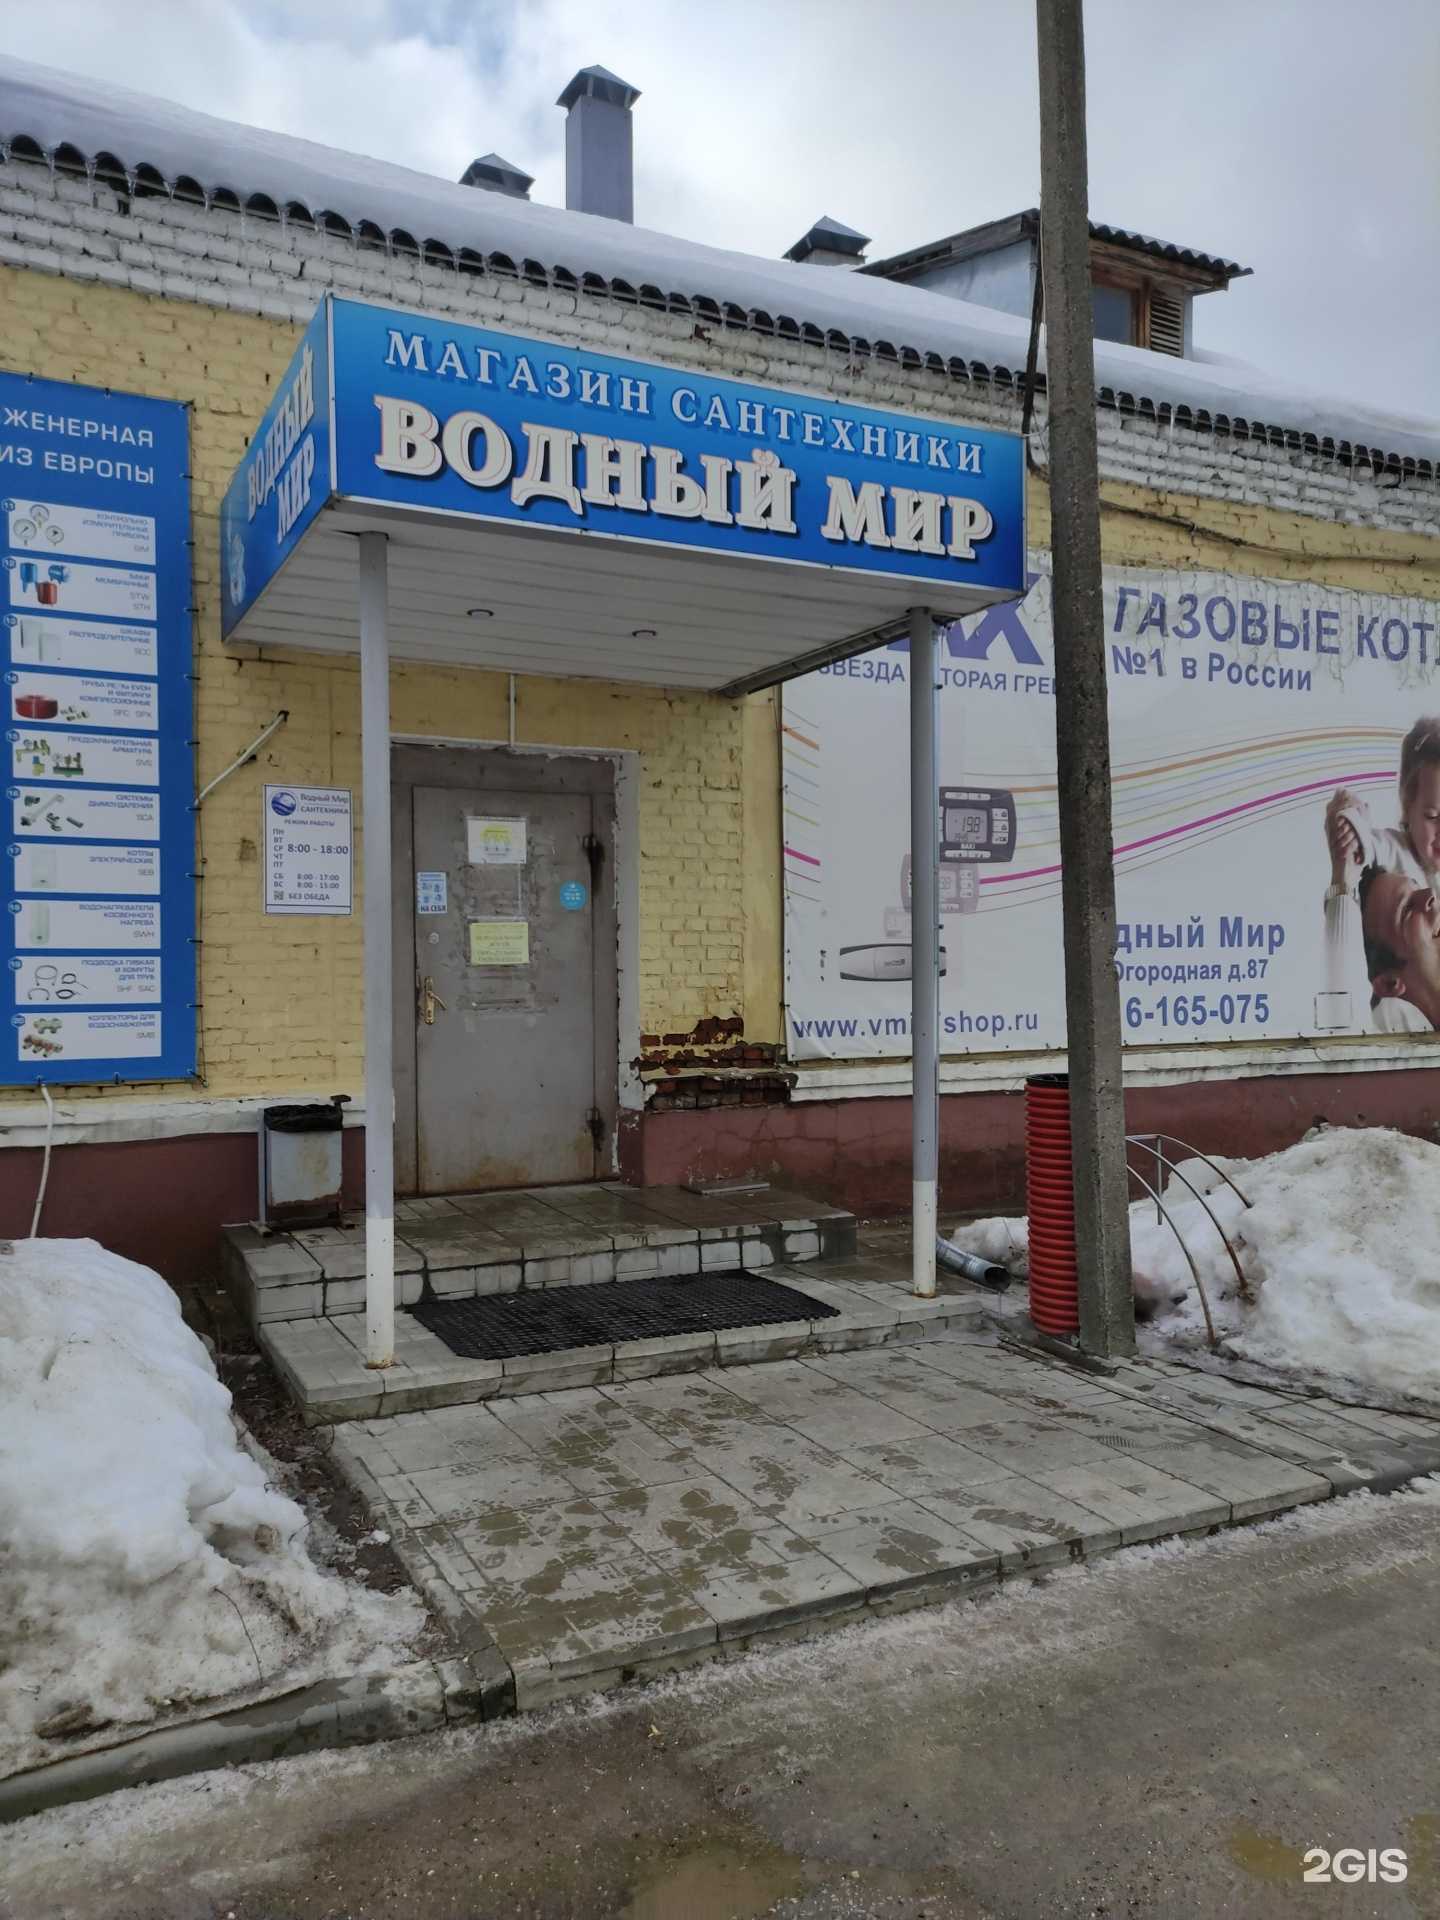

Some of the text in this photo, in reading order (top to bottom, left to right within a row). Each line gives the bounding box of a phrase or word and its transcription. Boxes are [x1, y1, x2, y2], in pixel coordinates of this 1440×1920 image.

[385, 329, 984, 474] МАГАЗИН САНТЕХНИКИ
[3, 407, 154, 448] ЖЕНЕРНАЯ
[247, 343, 314, 523] ВОДНЫЙ
[0, 444, 154, 485] ИЗ ЕВРОПЫ
[373, 395, 994, 560] ВОДНЫЙ МИР
[276, 434, 315, 545] МИР
[1113, 586, 1340, 655] ГАЗОВЫЕ
[1356, 614, 1440, 666] КОТ
[939, 667, 1007, 691] ТОРАЯ
[1013, 674, 1057, 695] ГРЕ
[1111, 644, 1312, 691] №1 в России
[287, 843, 311, 853] 8:00
[319, 844, 349, 855] 18:00
[1115, 915, 1285, 955] дный Мир
[1228, 958, 1269, 983] д.87
[792, 1010, 1039, 1038] www.vmshop.ru
[1125, 993, 1270, 1028] 6-165-075
